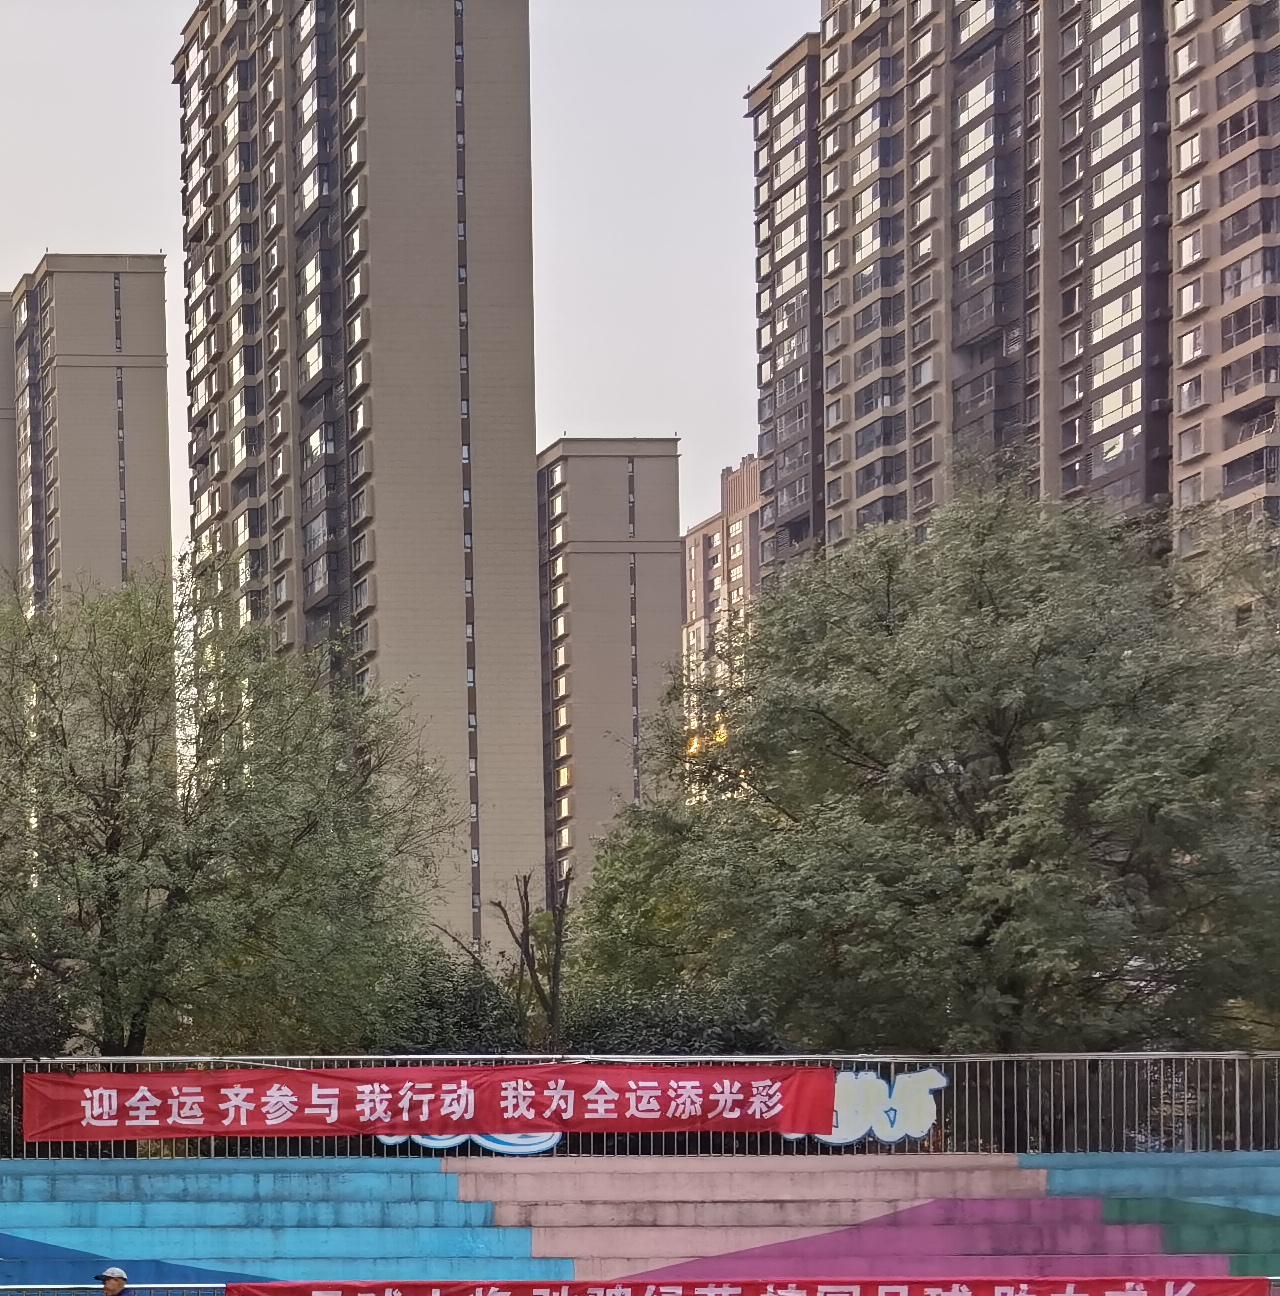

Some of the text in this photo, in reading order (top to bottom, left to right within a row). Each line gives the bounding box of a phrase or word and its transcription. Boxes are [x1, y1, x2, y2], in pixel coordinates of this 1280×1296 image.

[80, 1086, 205, 1127] 迎全运
[218, 1083, 340, 1126] 齐参与
[355, 1079, 476, 1123] 我行动
[500, 1078, 784, 1120] 我为全运添光彩
